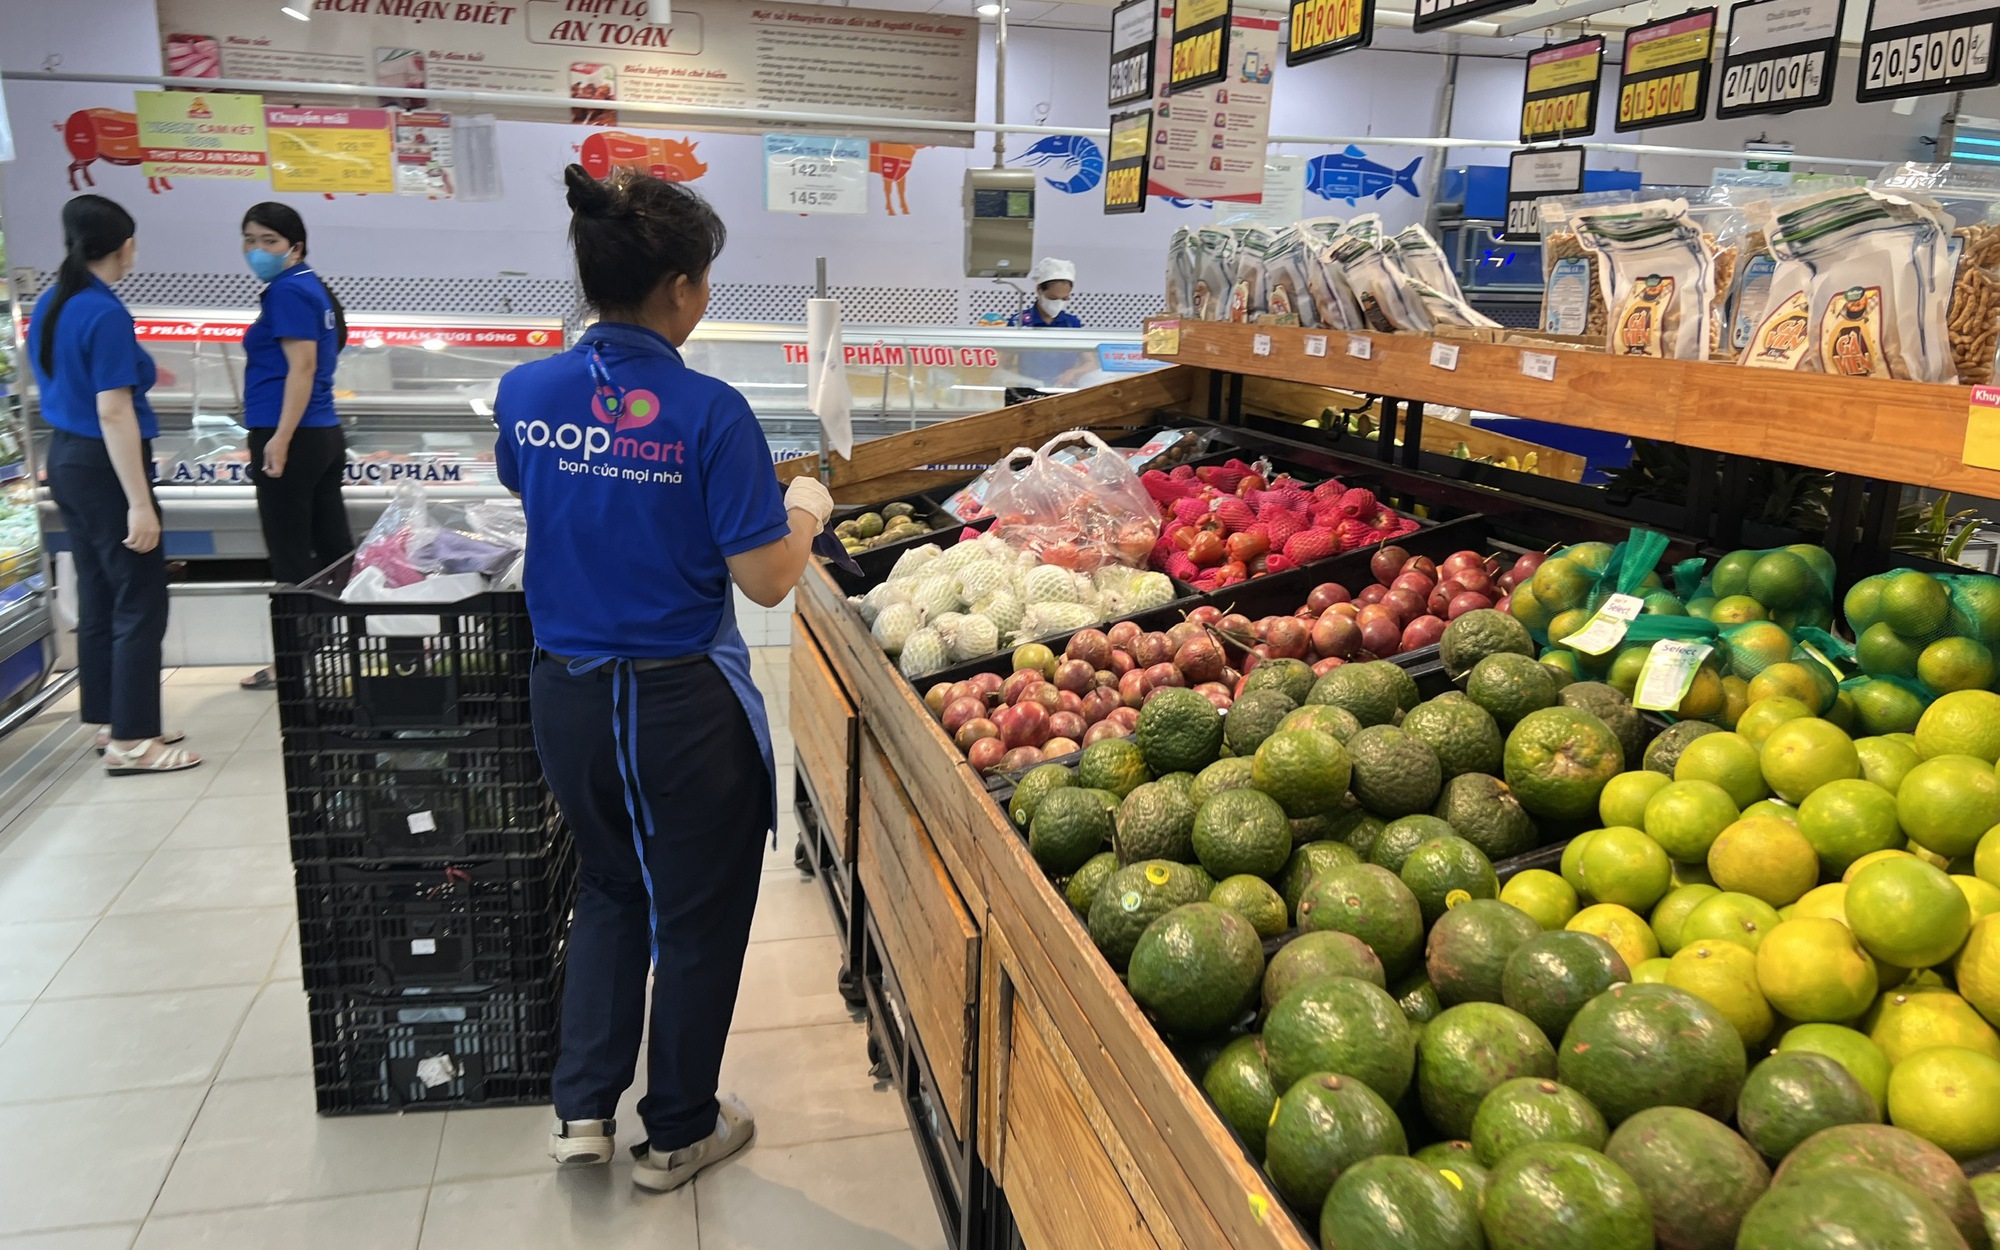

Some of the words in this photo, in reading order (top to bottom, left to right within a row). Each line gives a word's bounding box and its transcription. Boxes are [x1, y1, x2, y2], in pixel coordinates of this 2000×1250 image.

[549, 20, 593, 41] AN
[1295, 0, 1349, 45] 17.900
[1871, 36, 1965, 81] 20.500
[1726, 62, 1801, 98] 21.000
[1621, 83, 1682, 117] 31.500
[269, 110, 321, 127] Khuyến
[322, 112, 349, 124] mãi
[1525, 99, 1574, 127] 17.000
[1510, 206, 1538, 229] 21.0
[475, 330, 518, 343] SỐNG
[843, 340, 905, 366] PHẨM
[908, 345, 955, 367] TƯƠI
[960, 347, 999, 368] CTC
[1975, 389, 2000, 406] Khuy
[390, 457, 461, 482] PHẨM
[558, 458, 589, 476] bạn
[592, 463, 619, 478] của
[621, 469, 650, 485] mọi
[652, 471, 683, 485] nhà
[1607, 603, 1632, 615] Select
[1661, 643, 1698, 656] Select
